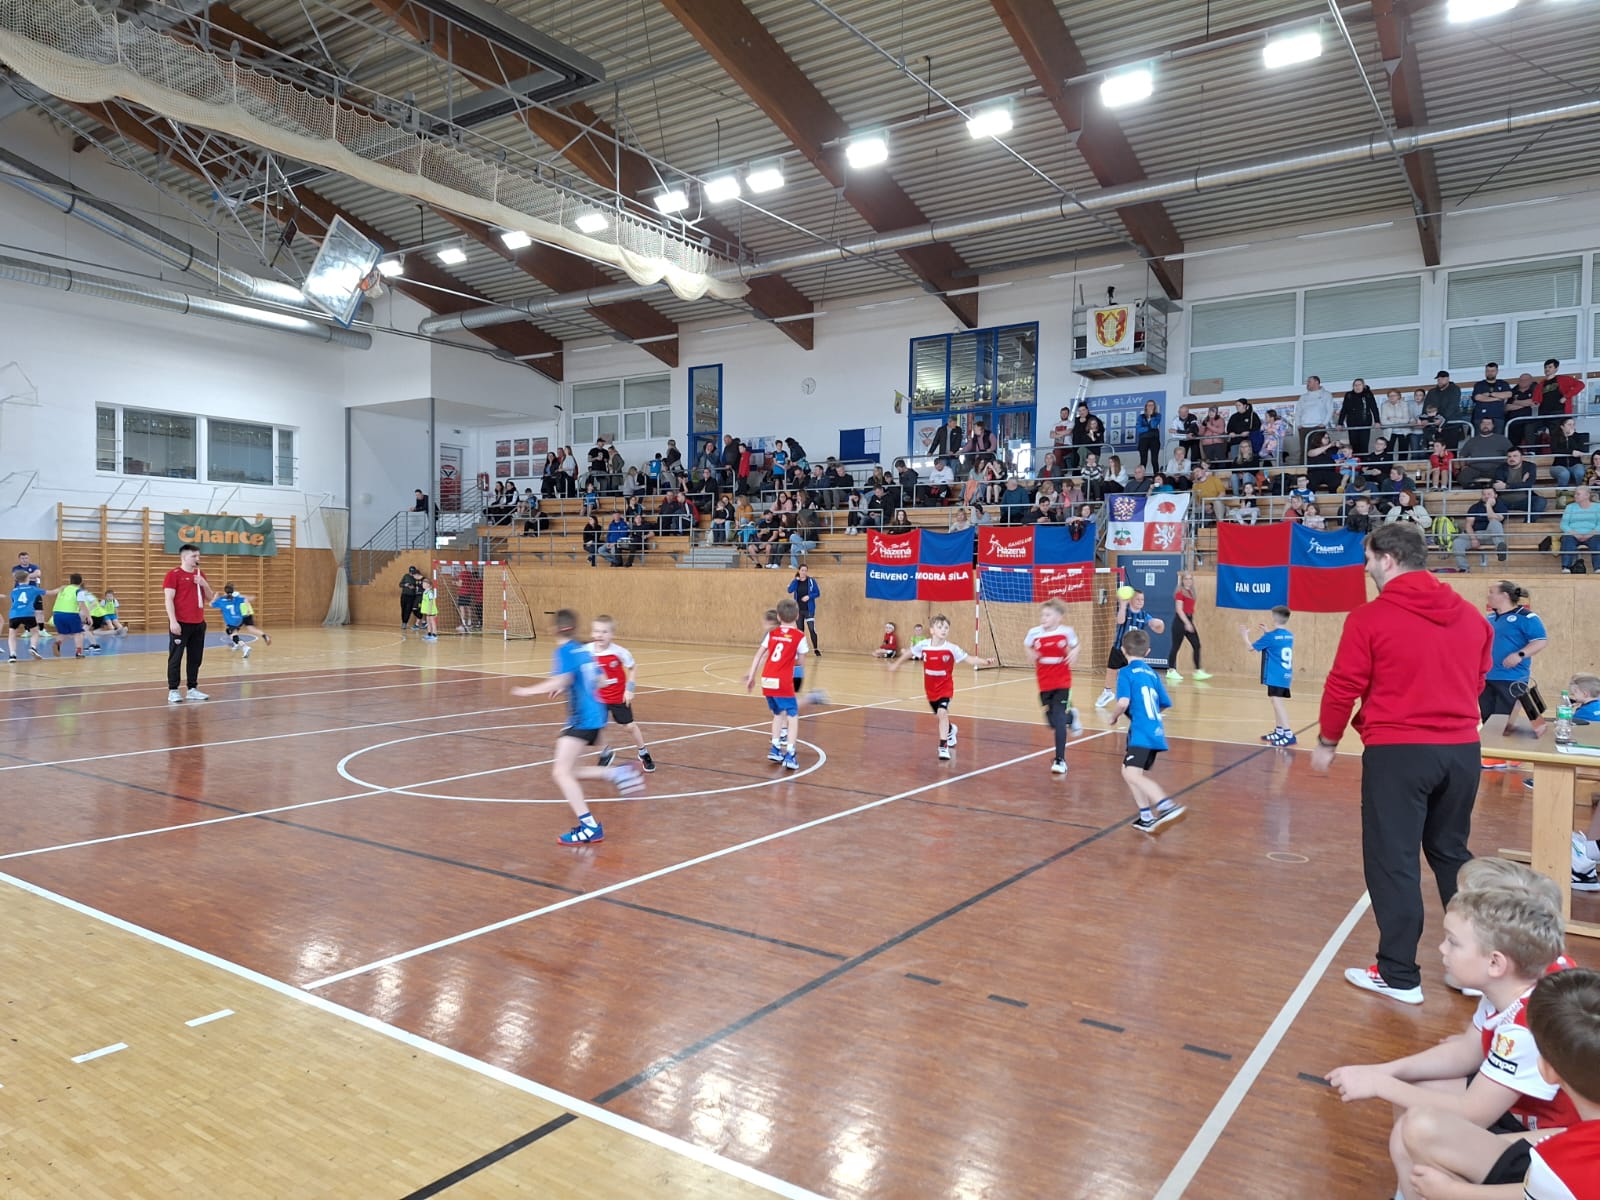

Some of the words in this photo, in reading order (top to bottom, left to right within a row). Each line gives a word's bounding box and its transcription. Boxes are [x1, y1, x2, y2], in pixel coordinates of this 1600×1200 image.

[178, 525, 265, 547] Chance
[870, 569, 909, 581] ČERVENO
[915, 571, 947, 581] MODRÁ
[948, 570, 969, 581] SÍLA
[1235, 582, 1250, 593] FAN
[1252, 582, 1271, 593] CLUB
[18, 591, 28, 604] 4
[226, 604, 236, 616] 7
[771, 642, 785, 662] 8
[1281, 647, 1293, 670] 9
